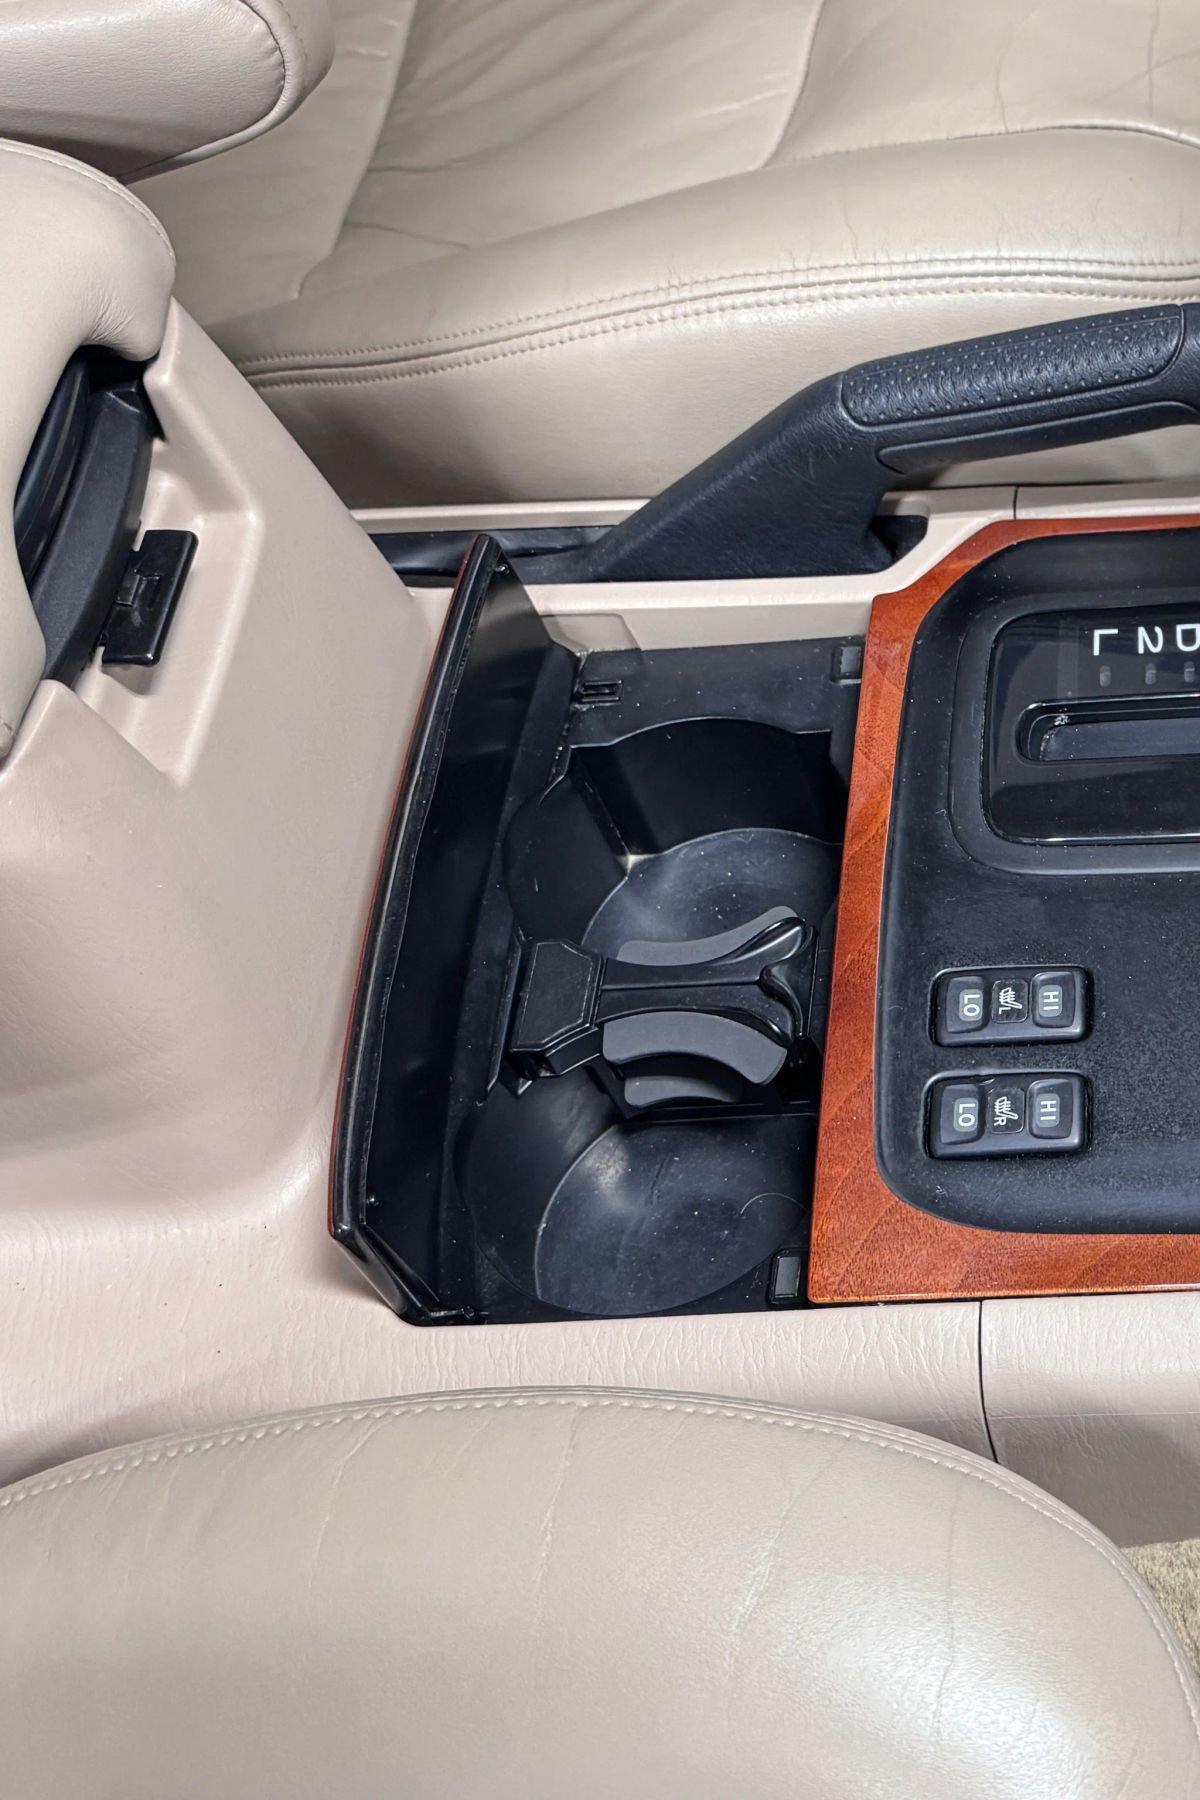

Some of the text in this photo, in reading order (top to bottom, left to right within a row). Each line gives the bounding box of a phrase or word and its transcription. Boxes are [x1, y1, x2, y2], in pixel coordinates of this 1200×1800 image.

[1092, 628, 1119, 656] L
[1137, 626, 1164, 655] 2
[1176, 623, 1200, 652] D
[963, 993, 981, 1017] LO
[1043, 991, 1060, 1010] HI
[958, 1103, 976, 1127] LO
[993, 1117, 1007, 1126] R
[1040, 1100, 1057, 1121] HI
